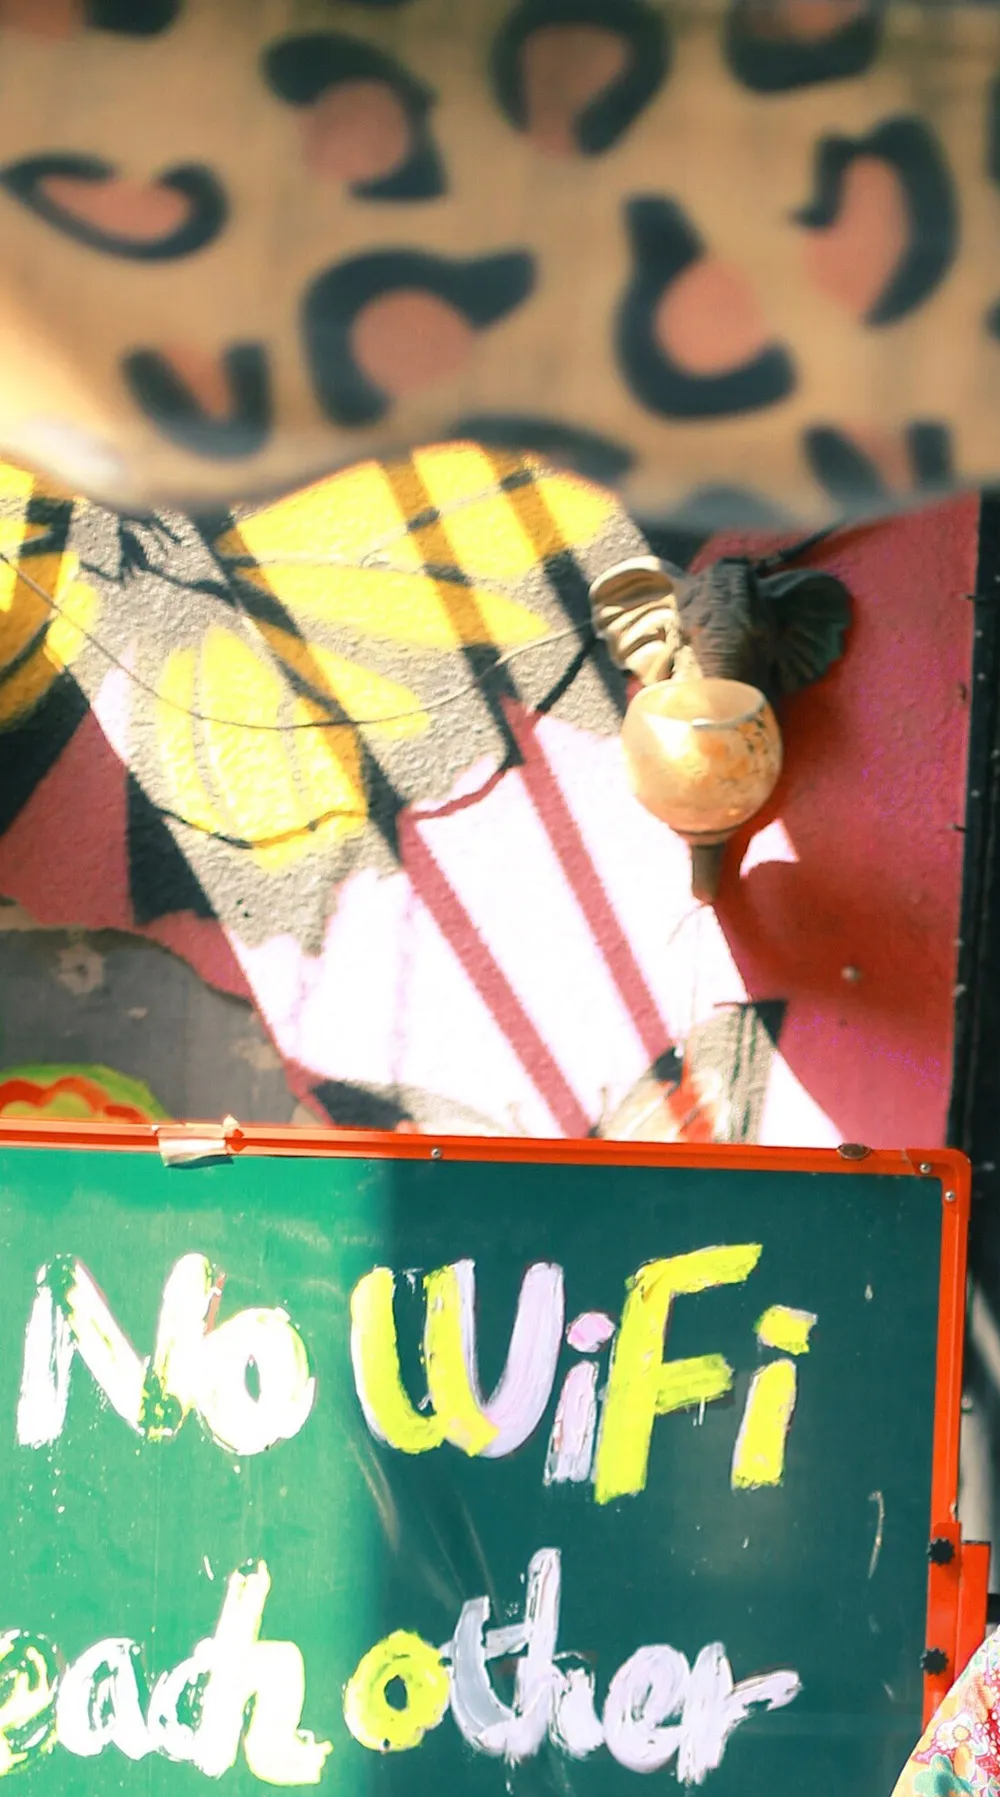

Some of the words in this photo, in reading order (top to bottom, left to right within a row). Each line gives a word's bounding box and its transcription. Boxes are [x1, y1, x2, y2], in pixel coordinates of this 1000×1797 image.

[16, 1253, 317, 1454] No
[349, 1243, 818, 1504] WiFi
[344, 1547, 802, 1784] other
